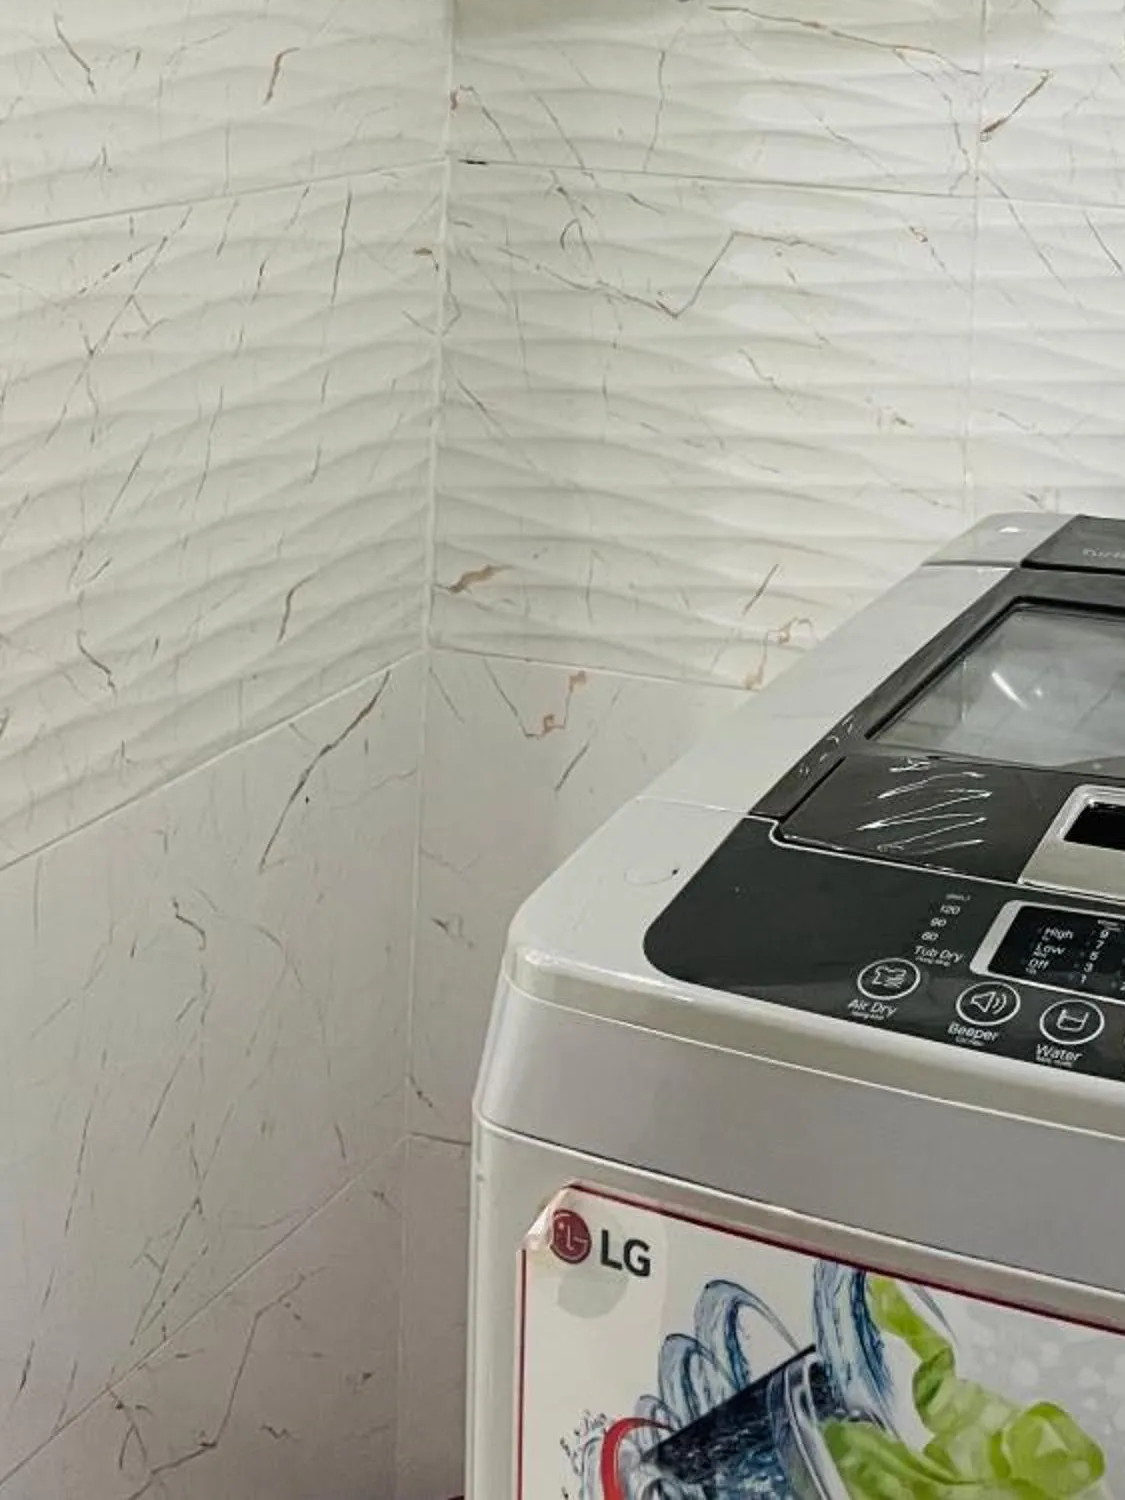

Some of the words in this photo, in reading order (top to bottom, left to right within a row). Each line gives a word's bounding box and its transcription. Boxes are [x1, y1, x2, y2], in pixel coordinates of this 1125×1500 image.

[939, 904, 961, 915] 120
[930, 917, 947, 927] 90
[921, 931, 939, 941] 60
[1044, 927, 1074, 941] High
[1100, 930, 1110, 939] 9
[1035, 942, 1067, 956] Low
[1096, 940, 1105, 950] 7
[914, 945, 938, 957] Tub
[939, 949, 964, 963] Dry
[1028, 958, 1050, 970] Off
[1083, 962, 1094, 973] 3
[848, 999, 869, 1011] Air
[870, 1001, 897, 1016] Dry
[948, 1021, 999, 1041] Beeper
[1036, 1043, 1083, 1062] Water
[600, 1229, 651, 1277] LG
